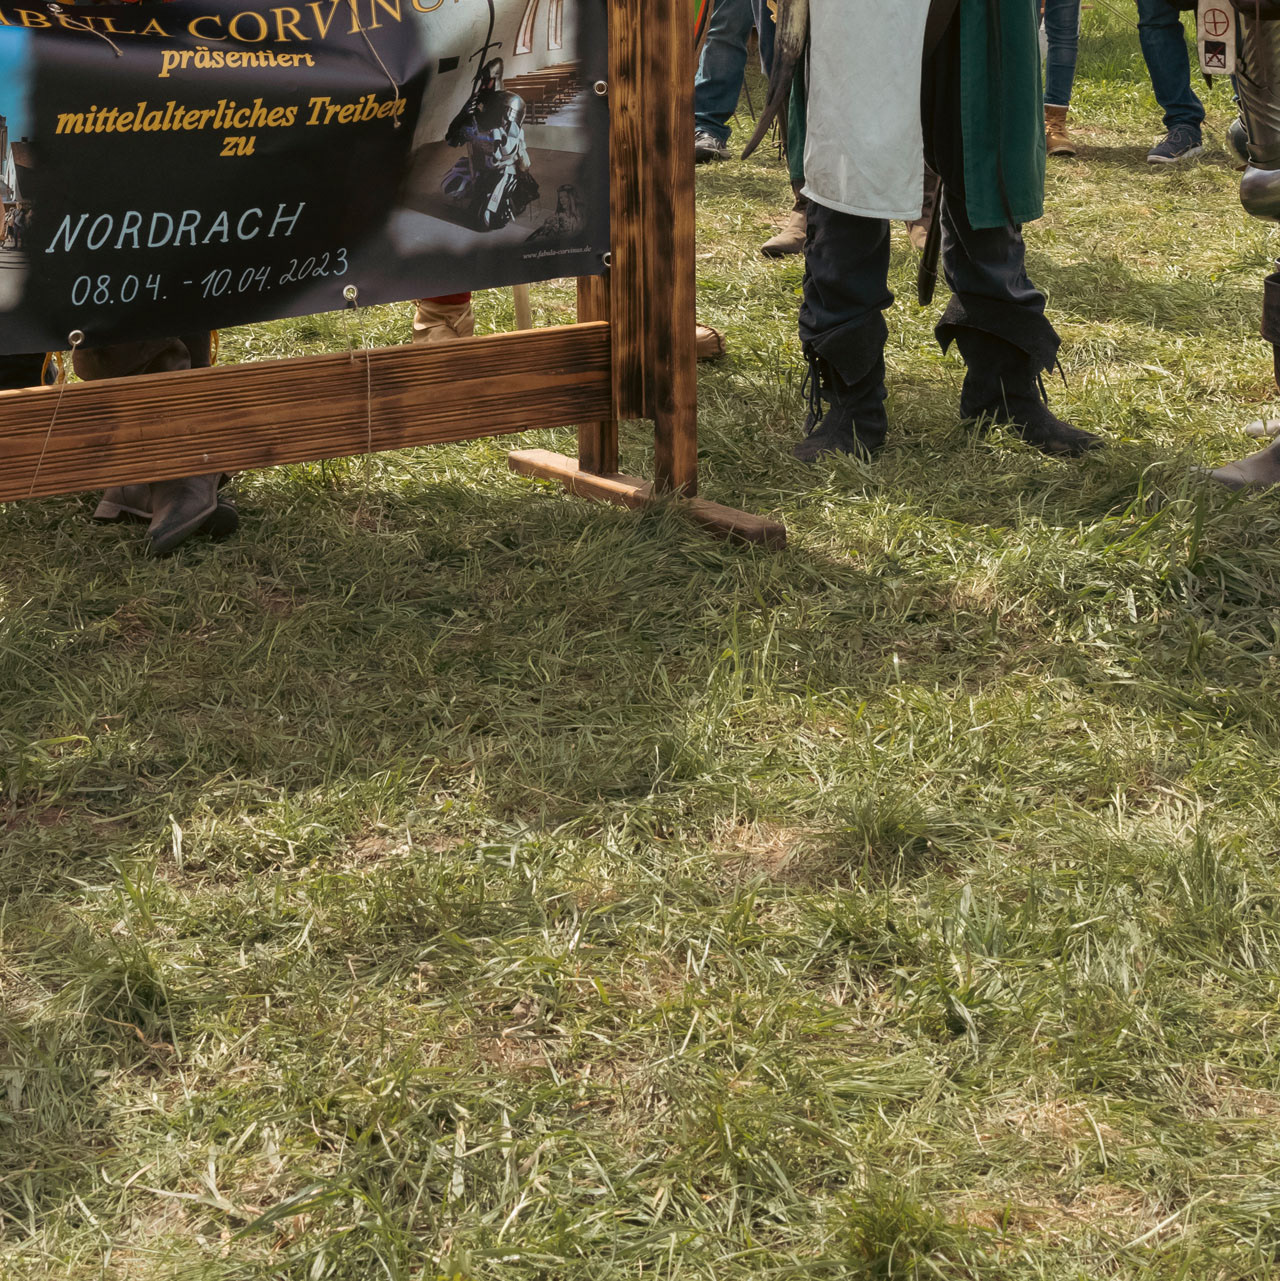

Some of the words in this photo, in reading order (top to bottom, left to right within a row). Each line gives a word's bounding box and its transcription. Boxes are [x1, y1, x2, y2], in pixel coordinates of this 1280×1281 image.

[158, 45, 316, 78] präsentiert
[55, 99, 299, 134] mittelalterliches
[305, 93, 407, 127] Treiben
[219, 136, 256, 157] zu
[45, 202, 306, 253] NORDRACH
[71, 274, 168, 306] 08.04.
